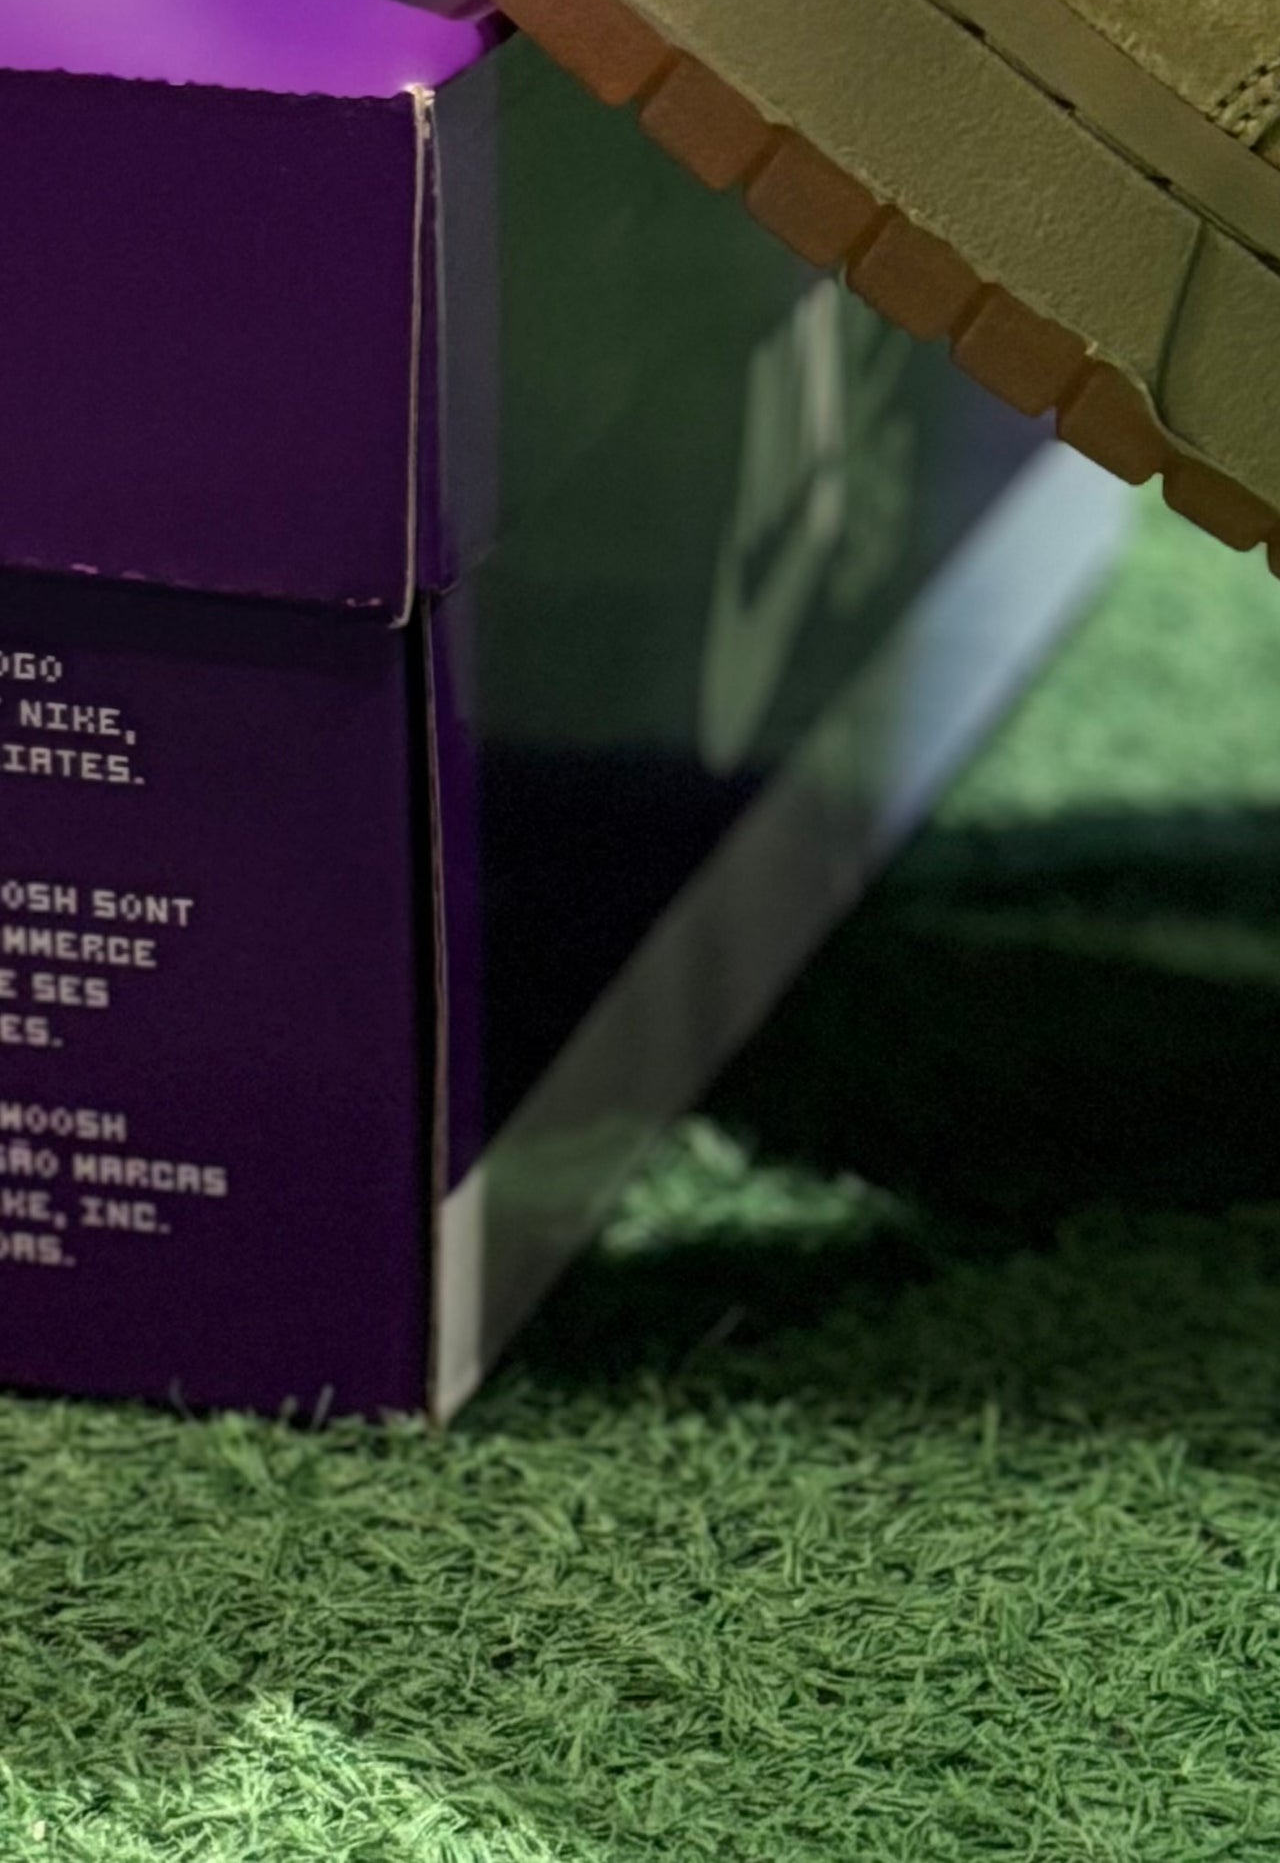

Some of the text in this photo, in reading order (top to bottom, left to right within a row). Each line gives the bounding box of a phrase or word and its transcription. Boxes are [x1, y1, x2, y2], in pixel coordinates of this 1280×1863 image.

[19, 700, 136, 744] NIKE,
[2, 743, 146, 785] IATES.
[92, 888, 195, 928] SONT
[2, 924, 158, 969] MMERCE
[31, 971, 111, 1009] SES
[0, 1138, 229, 1198] ÃO MARCAS
[79, 1195, 173, 1235] INC.
